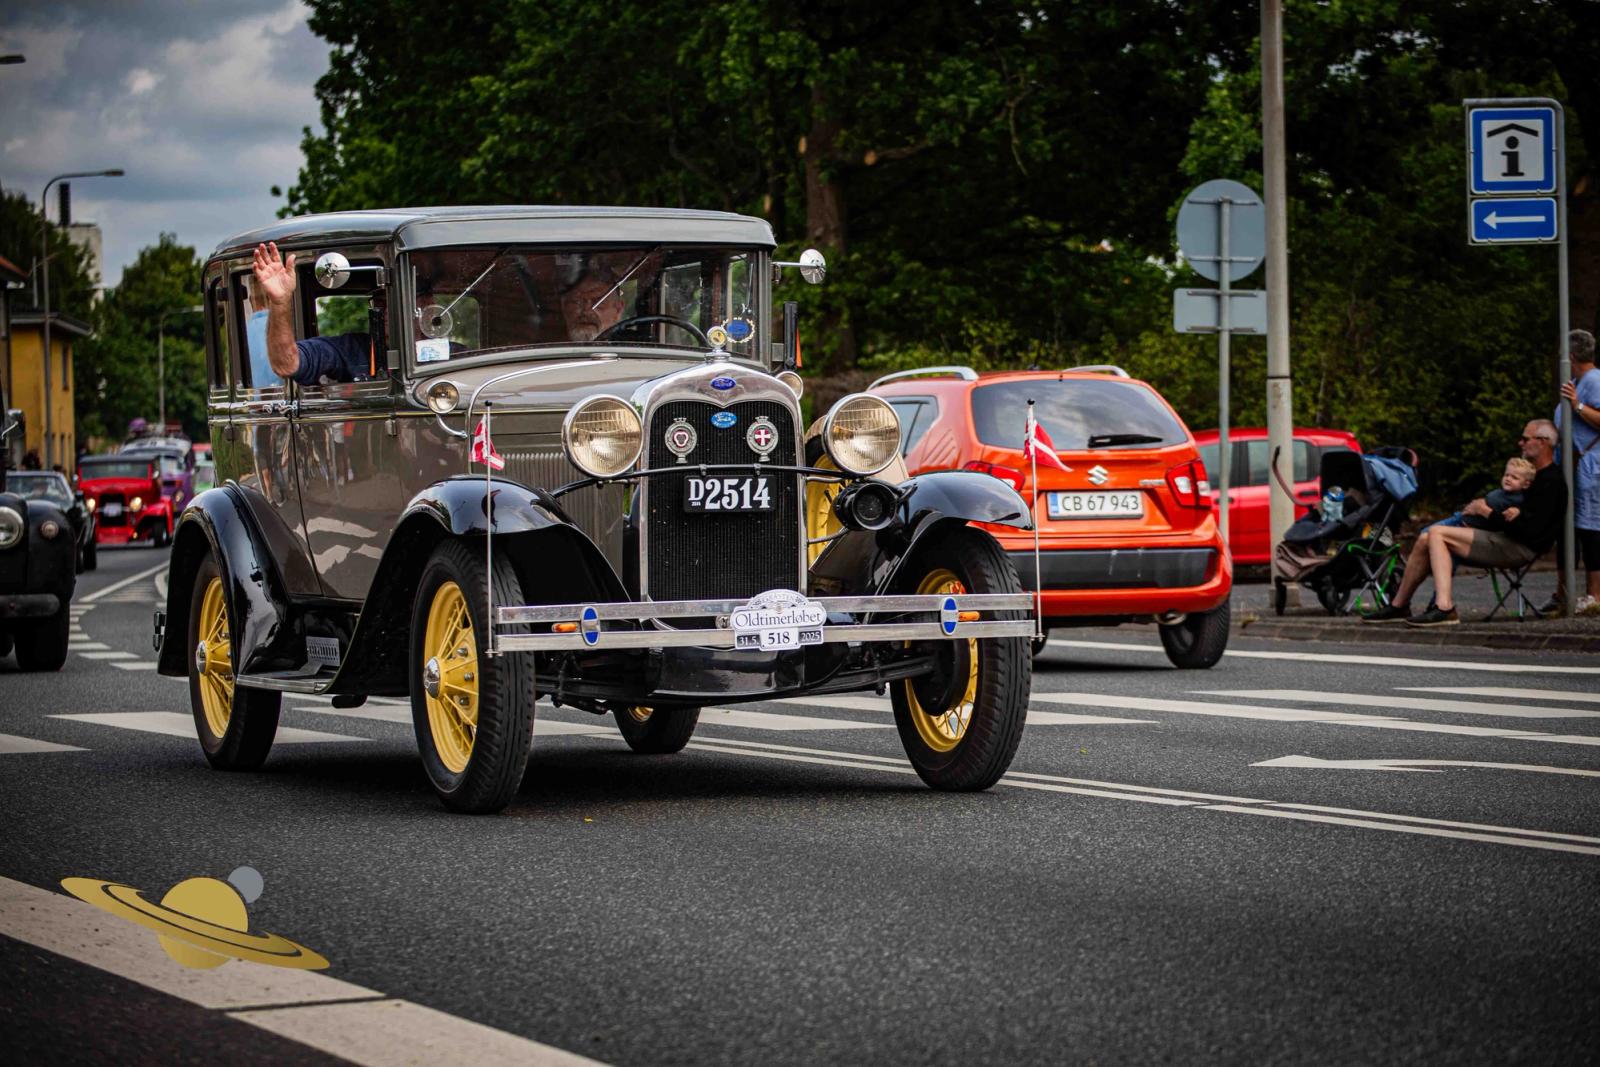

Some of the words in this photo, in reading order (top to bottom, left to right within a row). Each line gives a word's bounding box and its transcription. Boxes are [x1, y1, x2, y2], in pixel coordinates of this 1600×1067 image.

[688, 478, 770, 509] D2514
[1061, 495, 1083, 511] CB
[1087, 495, 1105, 510] 67
[1110, 494, 1139, 510] 943
[735, 610, 821, 627] Oldtimerløbet
[768, 632, 790, 645] 518
[801, 631, 820, 642] 2025
